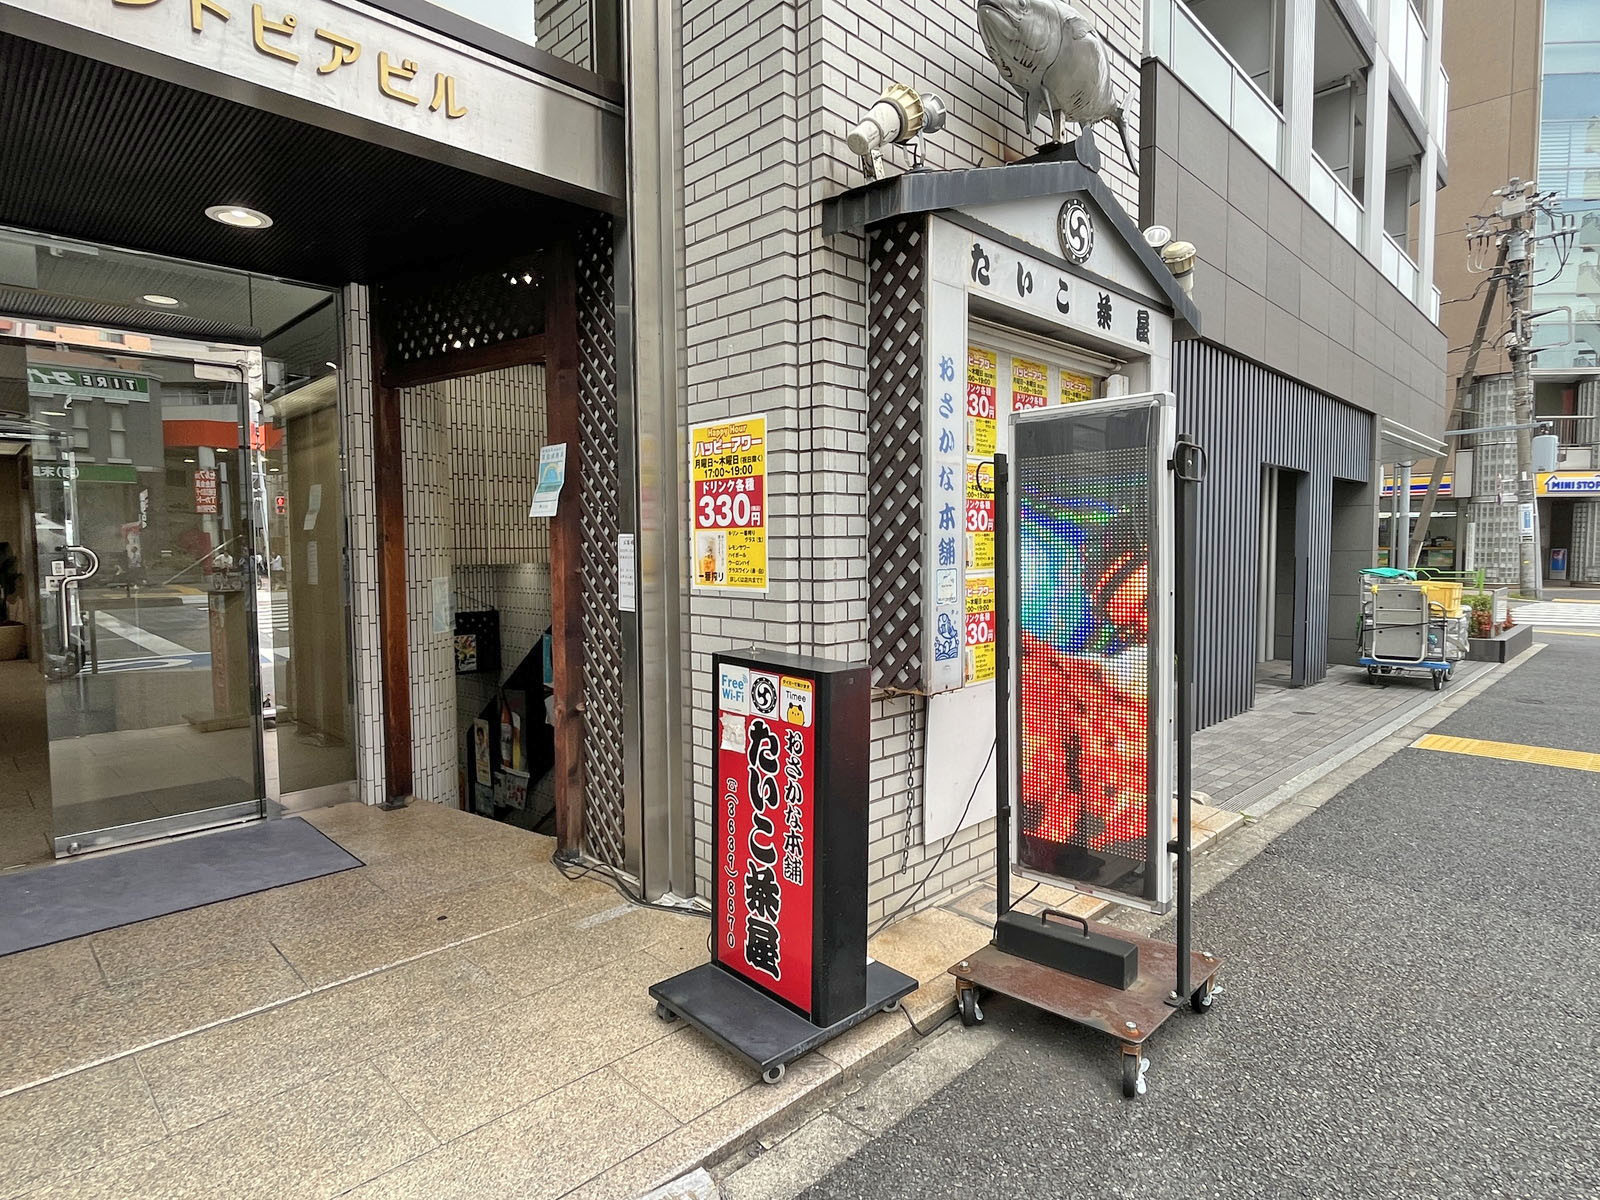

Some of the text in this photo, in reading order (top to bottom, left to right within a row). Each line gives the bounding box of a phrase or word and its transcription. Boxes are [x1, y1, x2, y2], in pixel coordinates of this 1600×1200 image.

[113, 0, 468, 119] トピアビル
[967, 394, 995, 418] 30円
[707, 424, 747, 439] Happy Hour
[694, 434, 763, 458] ハッピーアワー
[694, 455, 739, 469] 月曜日～木曜日
[938, 355, 956, 566] おさかな本舗
[704, 464, 753, 479] 17:00～19:00
[702, 477, 755, 494] ドリンク各種
[1552, 481, 1575, 490] MINI
[698, 492, 761, 528] 330円
[966, 510, 994, 532] 30円
[698, 571, 724, 582] 一番搾り
[966, 622, 993, 645] 30円
[721, 674, 744, 690] Free
[722, 689, 744, 703] Wi-Fi
[786, 690, 807, 703] Timee
[782, 728, 804, 886] おさかな本舗
[744, 717, 781, 982] たいこ茶屋
